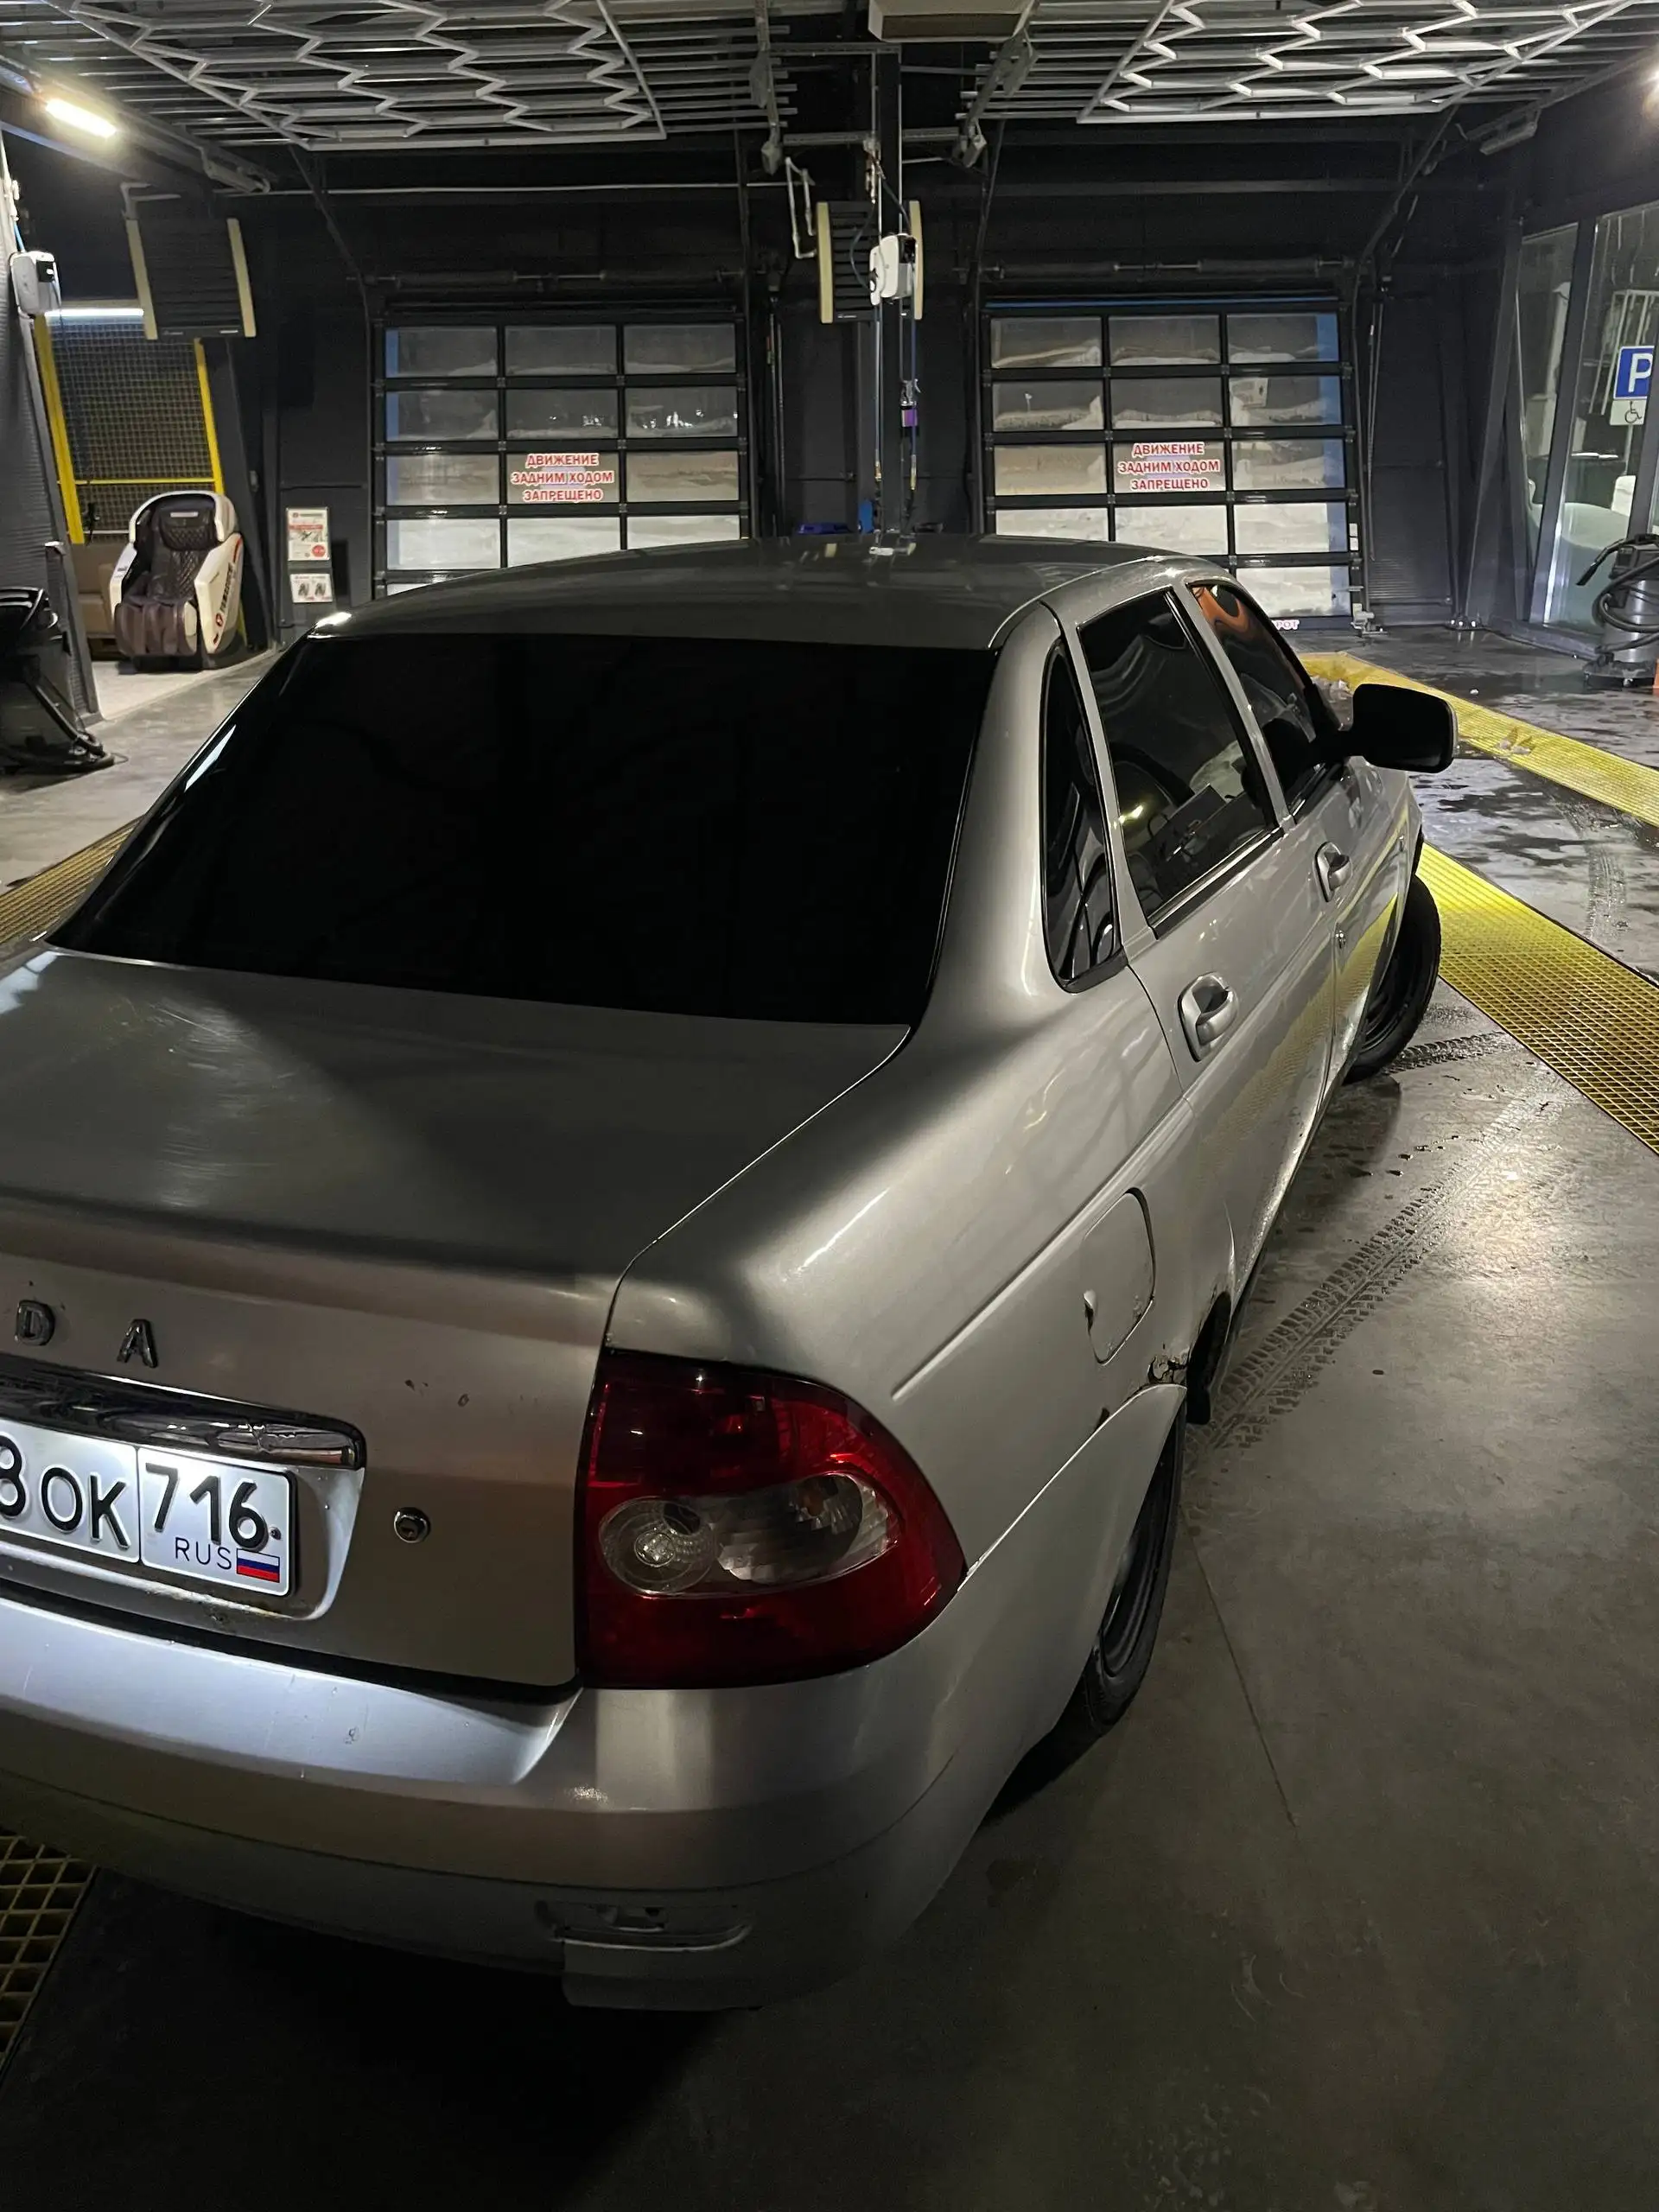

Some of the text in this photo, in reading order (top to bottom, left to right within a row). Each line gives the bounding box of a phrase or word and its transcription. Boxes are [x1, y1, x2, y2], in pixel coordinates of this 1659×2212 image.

[1627, 353, 1653, 393] P
[1133, 442, 1204, 455] ДВИЖЕНИЕ
[526, 454, 599, 467] ДВИЖЕНИЕ
[1118, 460, 1219, 474] ЗАДНИМ ХОДОМ
[512, 471, 613, 485] ЗАДНИМ ХОДОМ
[1130, 478, 1209, 491] ЗАПРЕЩЕНО
[523, 489, 602, 502] ЗАПРЕЩЕНО
[145, 1462, 269, 1549] 716
[175, 1537, 233, 1571] RUS
